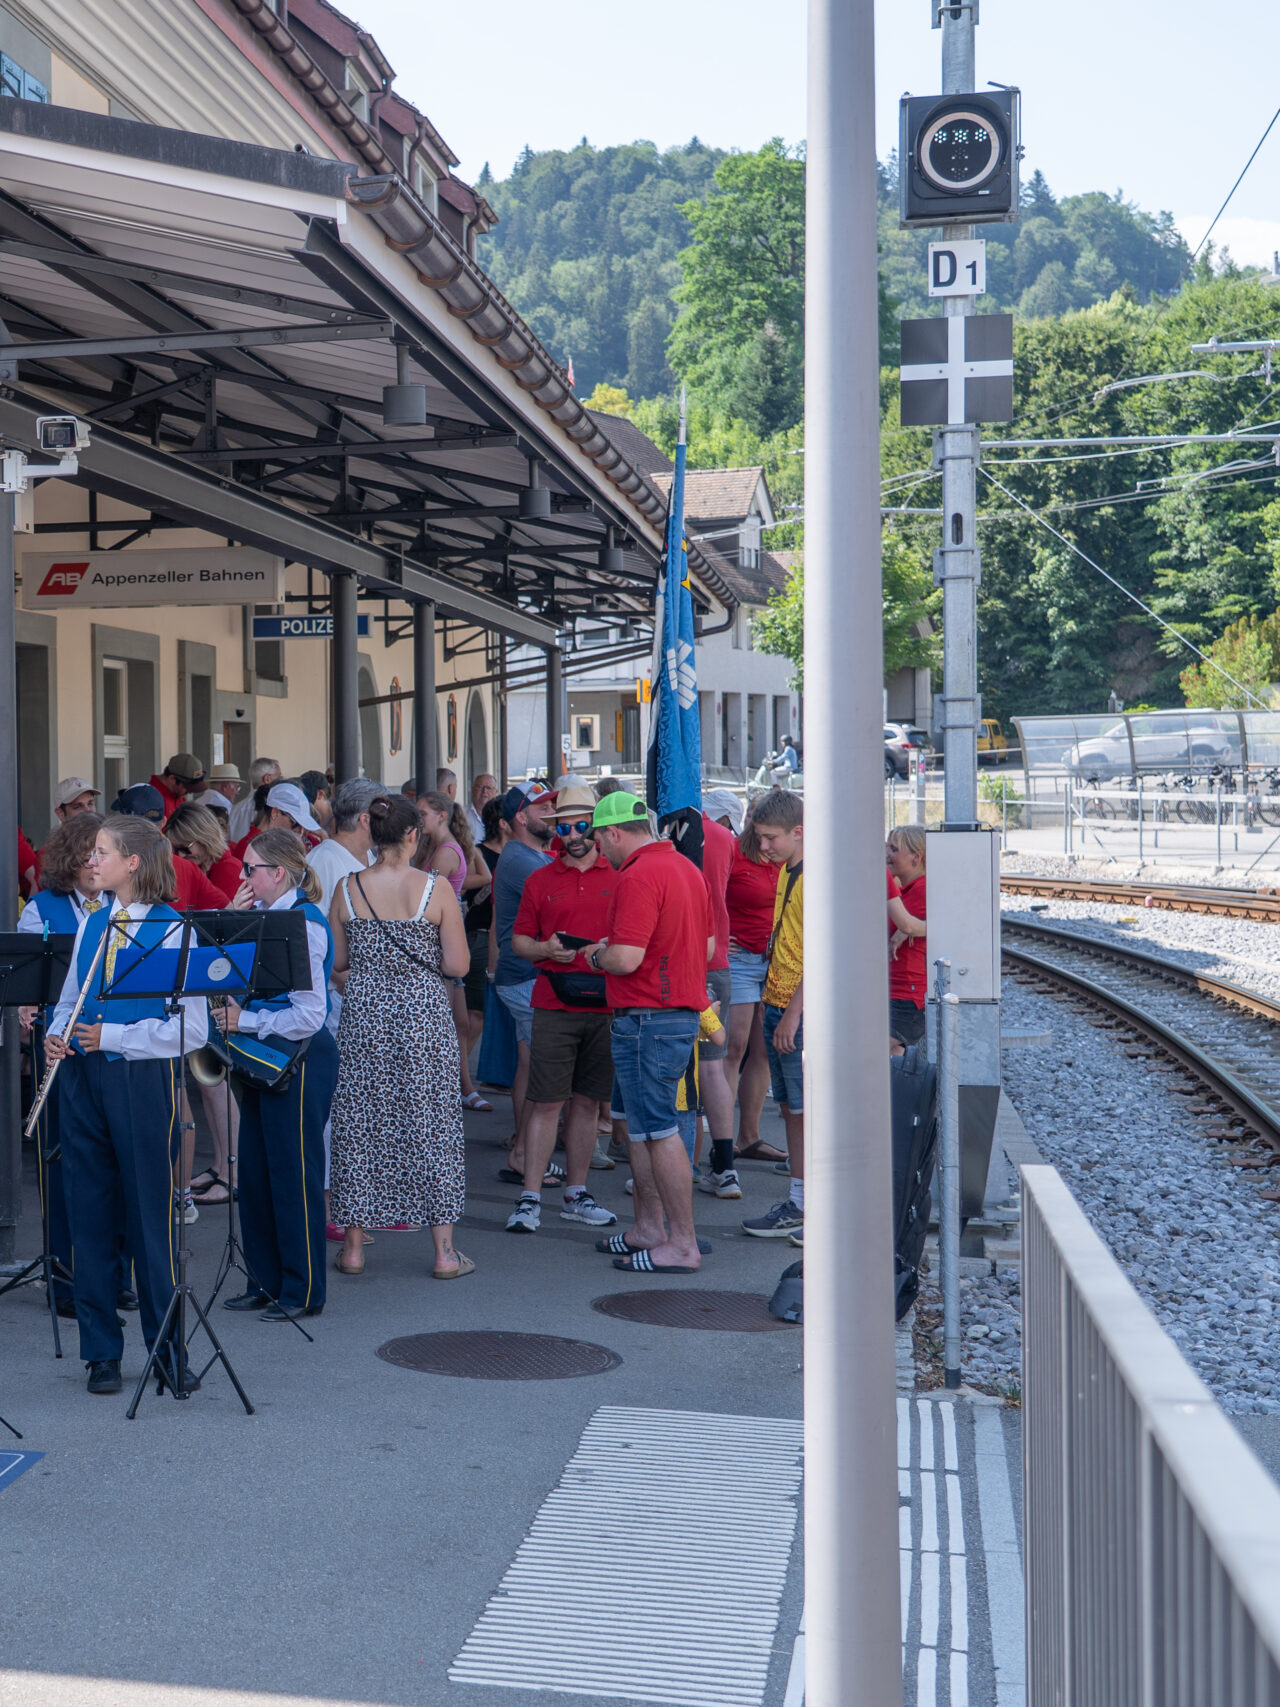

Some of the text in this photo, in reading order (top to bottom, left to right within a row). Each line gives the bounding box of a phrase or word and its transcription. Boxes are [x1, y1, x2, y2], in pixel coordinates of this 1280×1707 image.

[47, 569, 265, 587] AB Appenzeller Bahnen
[281, 619, 333, 634] POLIZE
[659, 956, 671, 1002] TEUFEN
